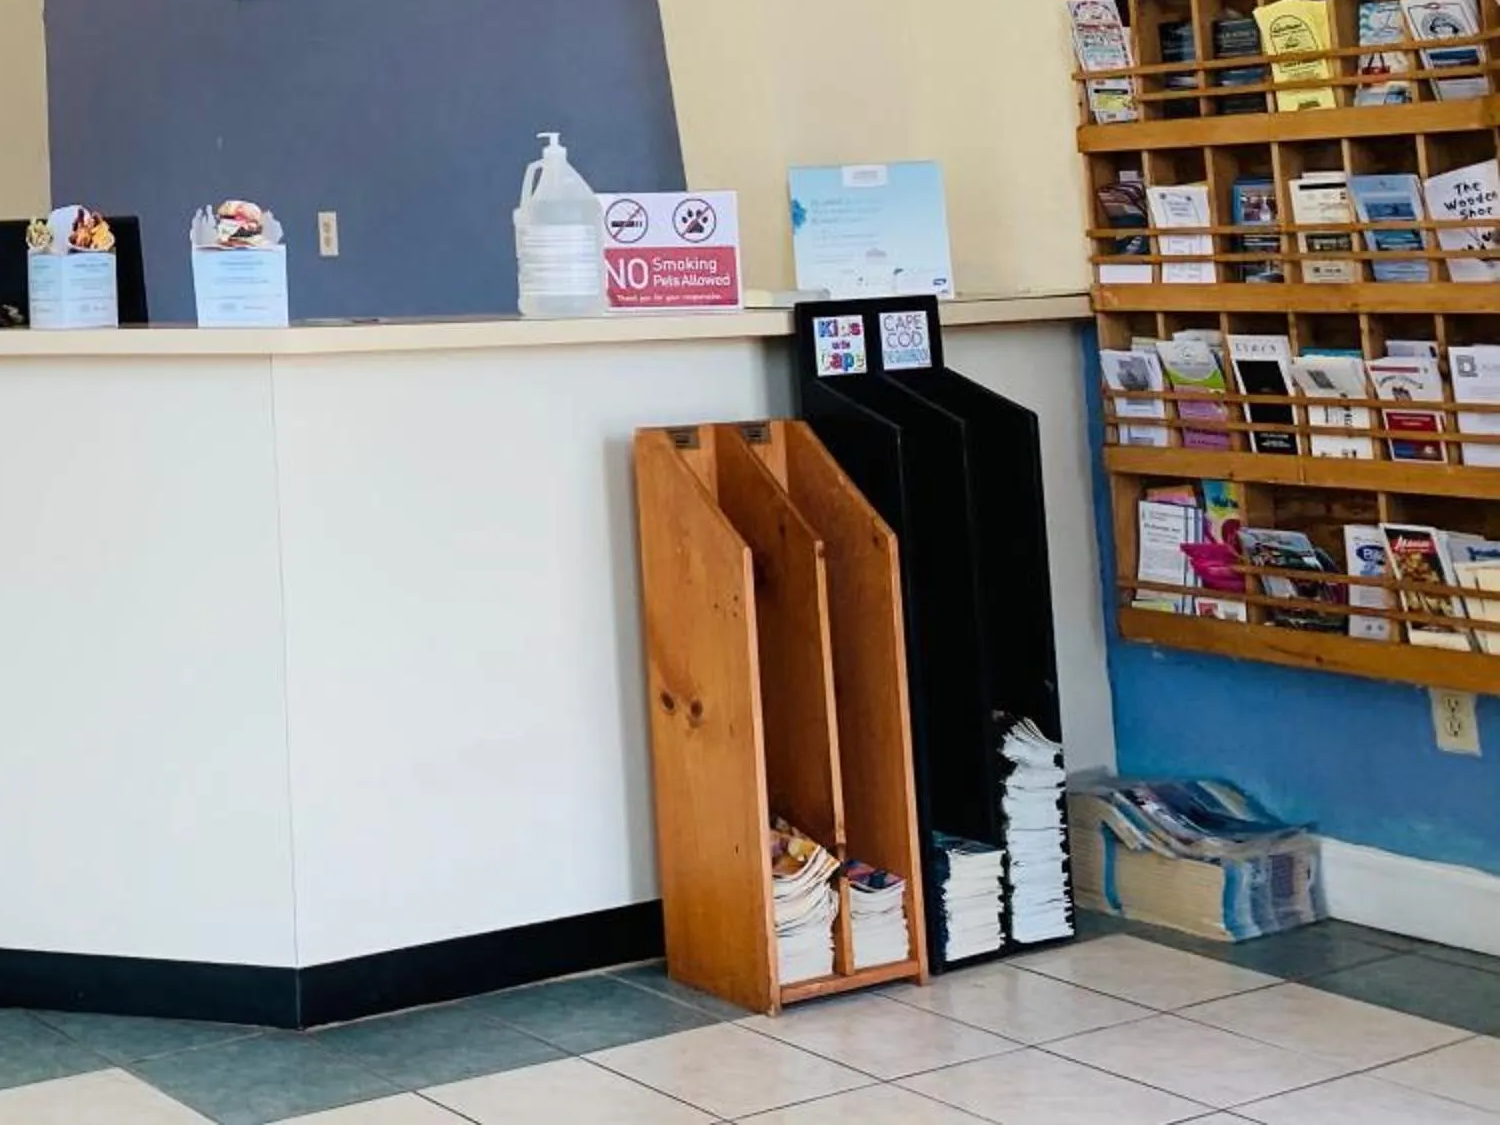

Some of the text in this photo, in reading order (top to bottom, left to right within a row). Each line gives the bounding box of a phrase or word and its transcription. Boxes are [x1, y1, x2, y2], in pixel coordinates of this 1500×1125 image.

[652, 256, 717, 272] Smoking
[604, 257, 649, 290] NO
[653, 272, 731, 286] Pets Allowed
[883, 314, 924, 332] CAPE
[886, 330, 924, 348] COD
